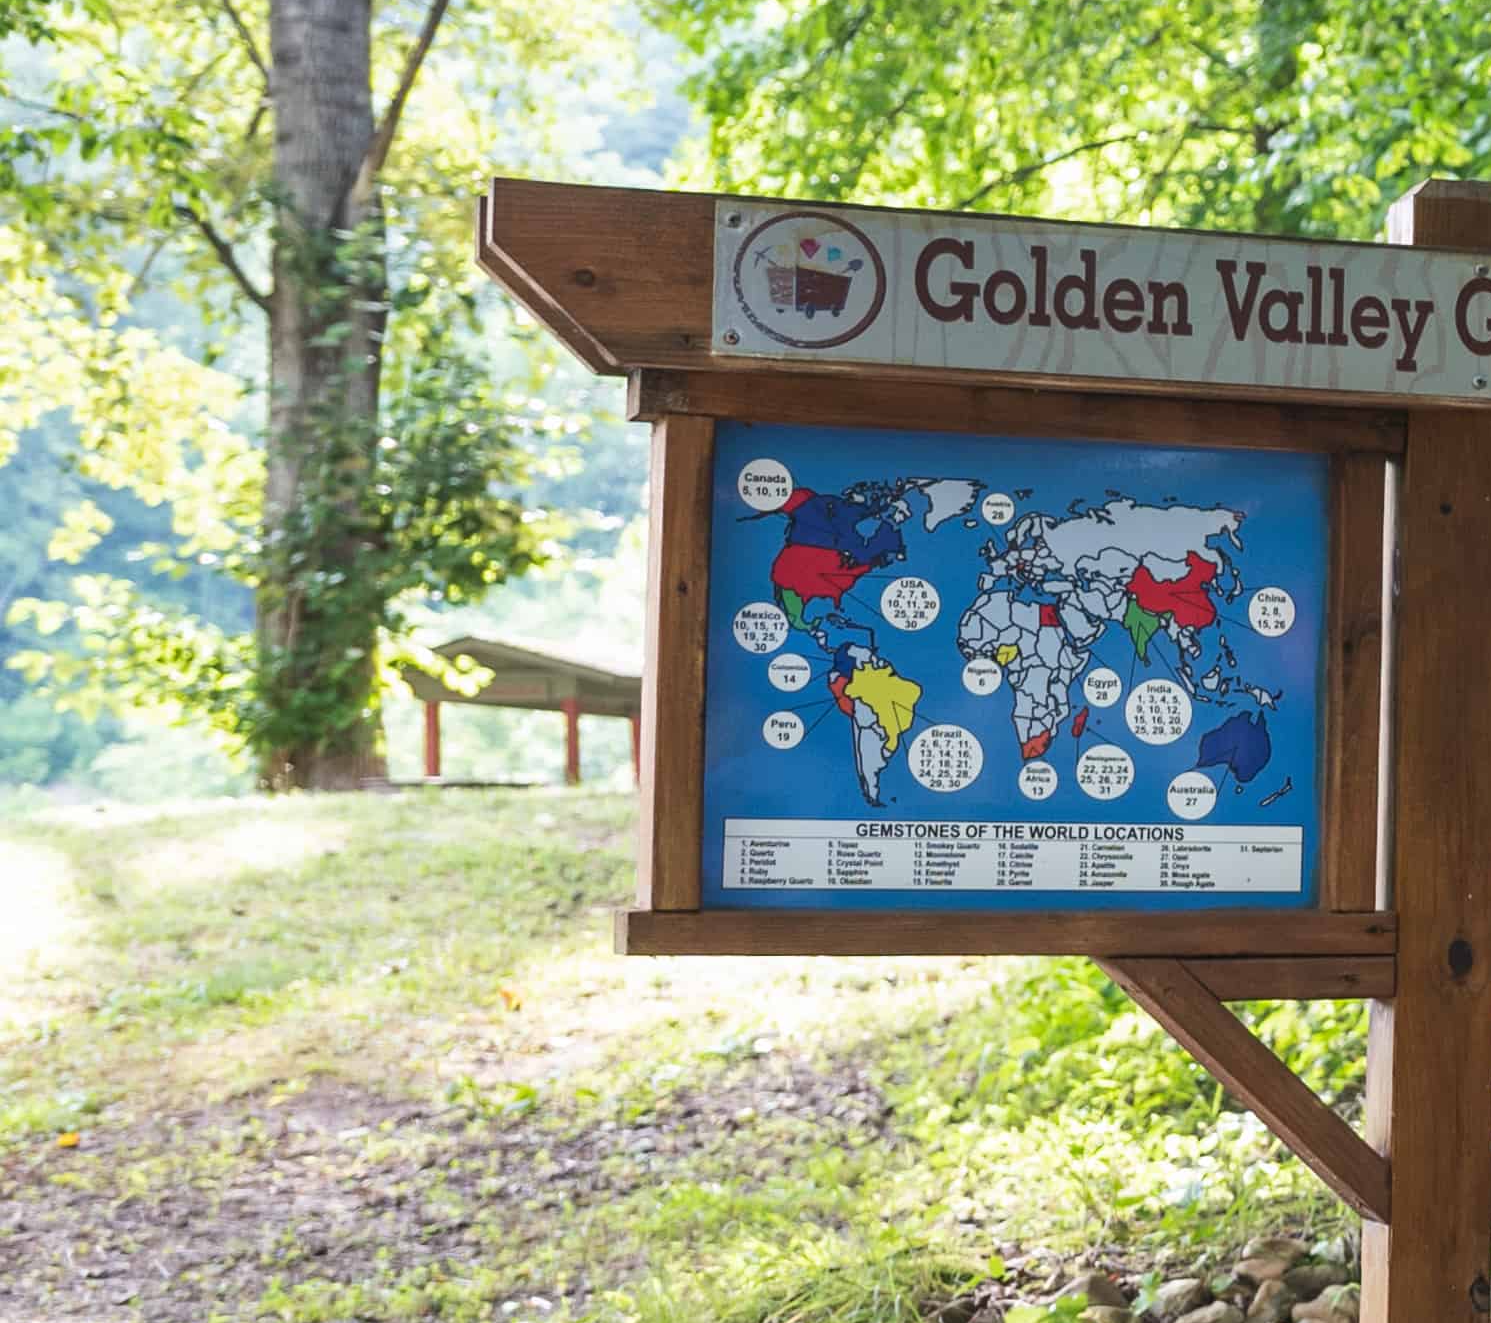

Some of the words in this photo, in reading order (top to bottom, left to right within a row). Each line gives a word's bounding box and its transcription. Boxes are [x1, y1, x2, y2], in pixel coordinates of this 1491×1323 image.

[914, 237, 1194, 337] Golden
[1216, 258, 1434, 373] Valley
[744, 472, 786, 483] Canada
[900, 580, 924, 589] USA
[1257, 592, 1286, 603] China
[742, 610, 781, 620] Mexico
[783, 674, 796, 684] 14
[1087, 677, 1118, 688] Egypt
[1146, 684, 1171, 693] India
[770, 719, 797, 729] Peru
[777, 732, 789, 741] 19
[931, 729, 962, 738] Brazil
[1169, 785, 1214, 794] Australia
[1185, 797, 1197, 806] 27
[856, 824, 961, 838] GEMSTONES
[966, 825, 987, 838] OF
[993, 825, 1024, 839] THE
[1029, 826, 1089, 840] WORLD
[1094, 827, 1185, 841] LOCATIONS
